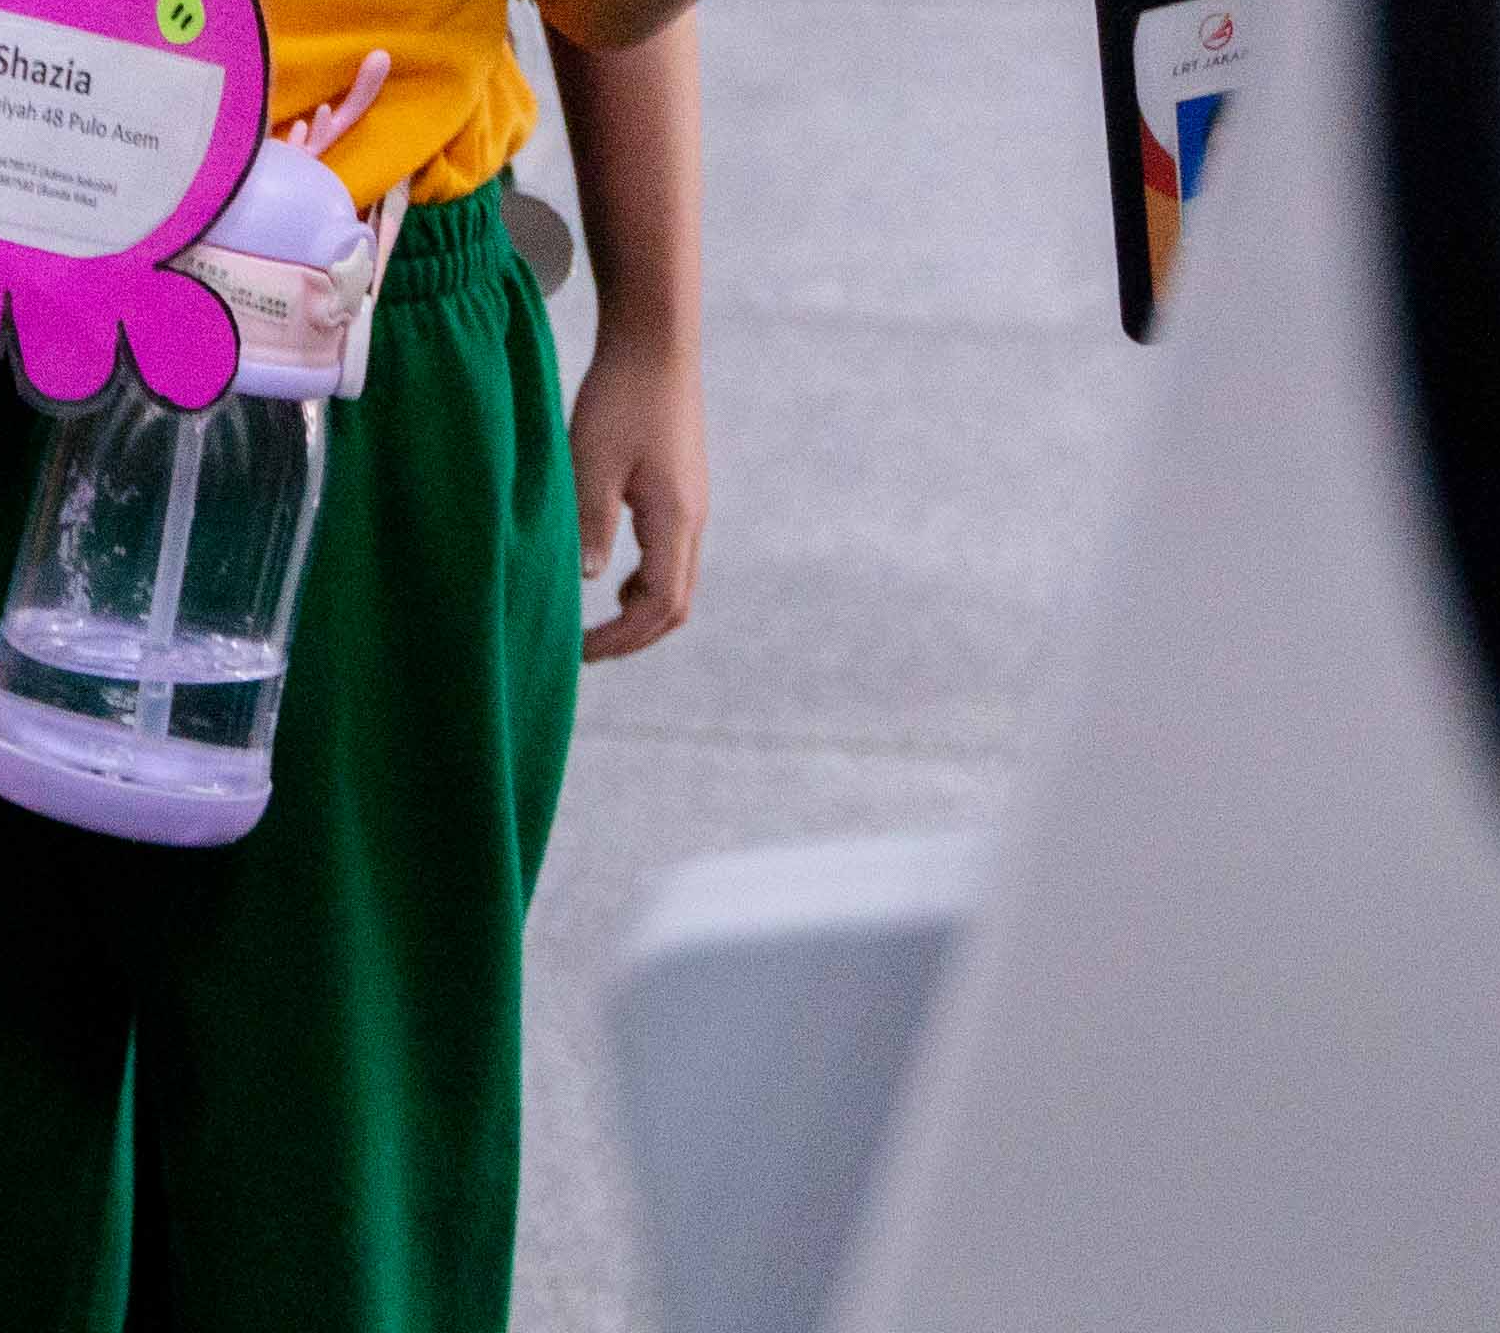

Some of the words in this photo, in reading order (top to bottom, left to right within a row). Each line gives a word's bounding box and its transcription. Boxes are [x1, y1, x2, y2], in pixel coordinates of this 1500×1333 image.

[1172, 59, 1198, 76] LRT
[41, 105, 65, 126] 48
[68, 114, 107, 139] Pulo
[111, 123, 161, 151] Asem
